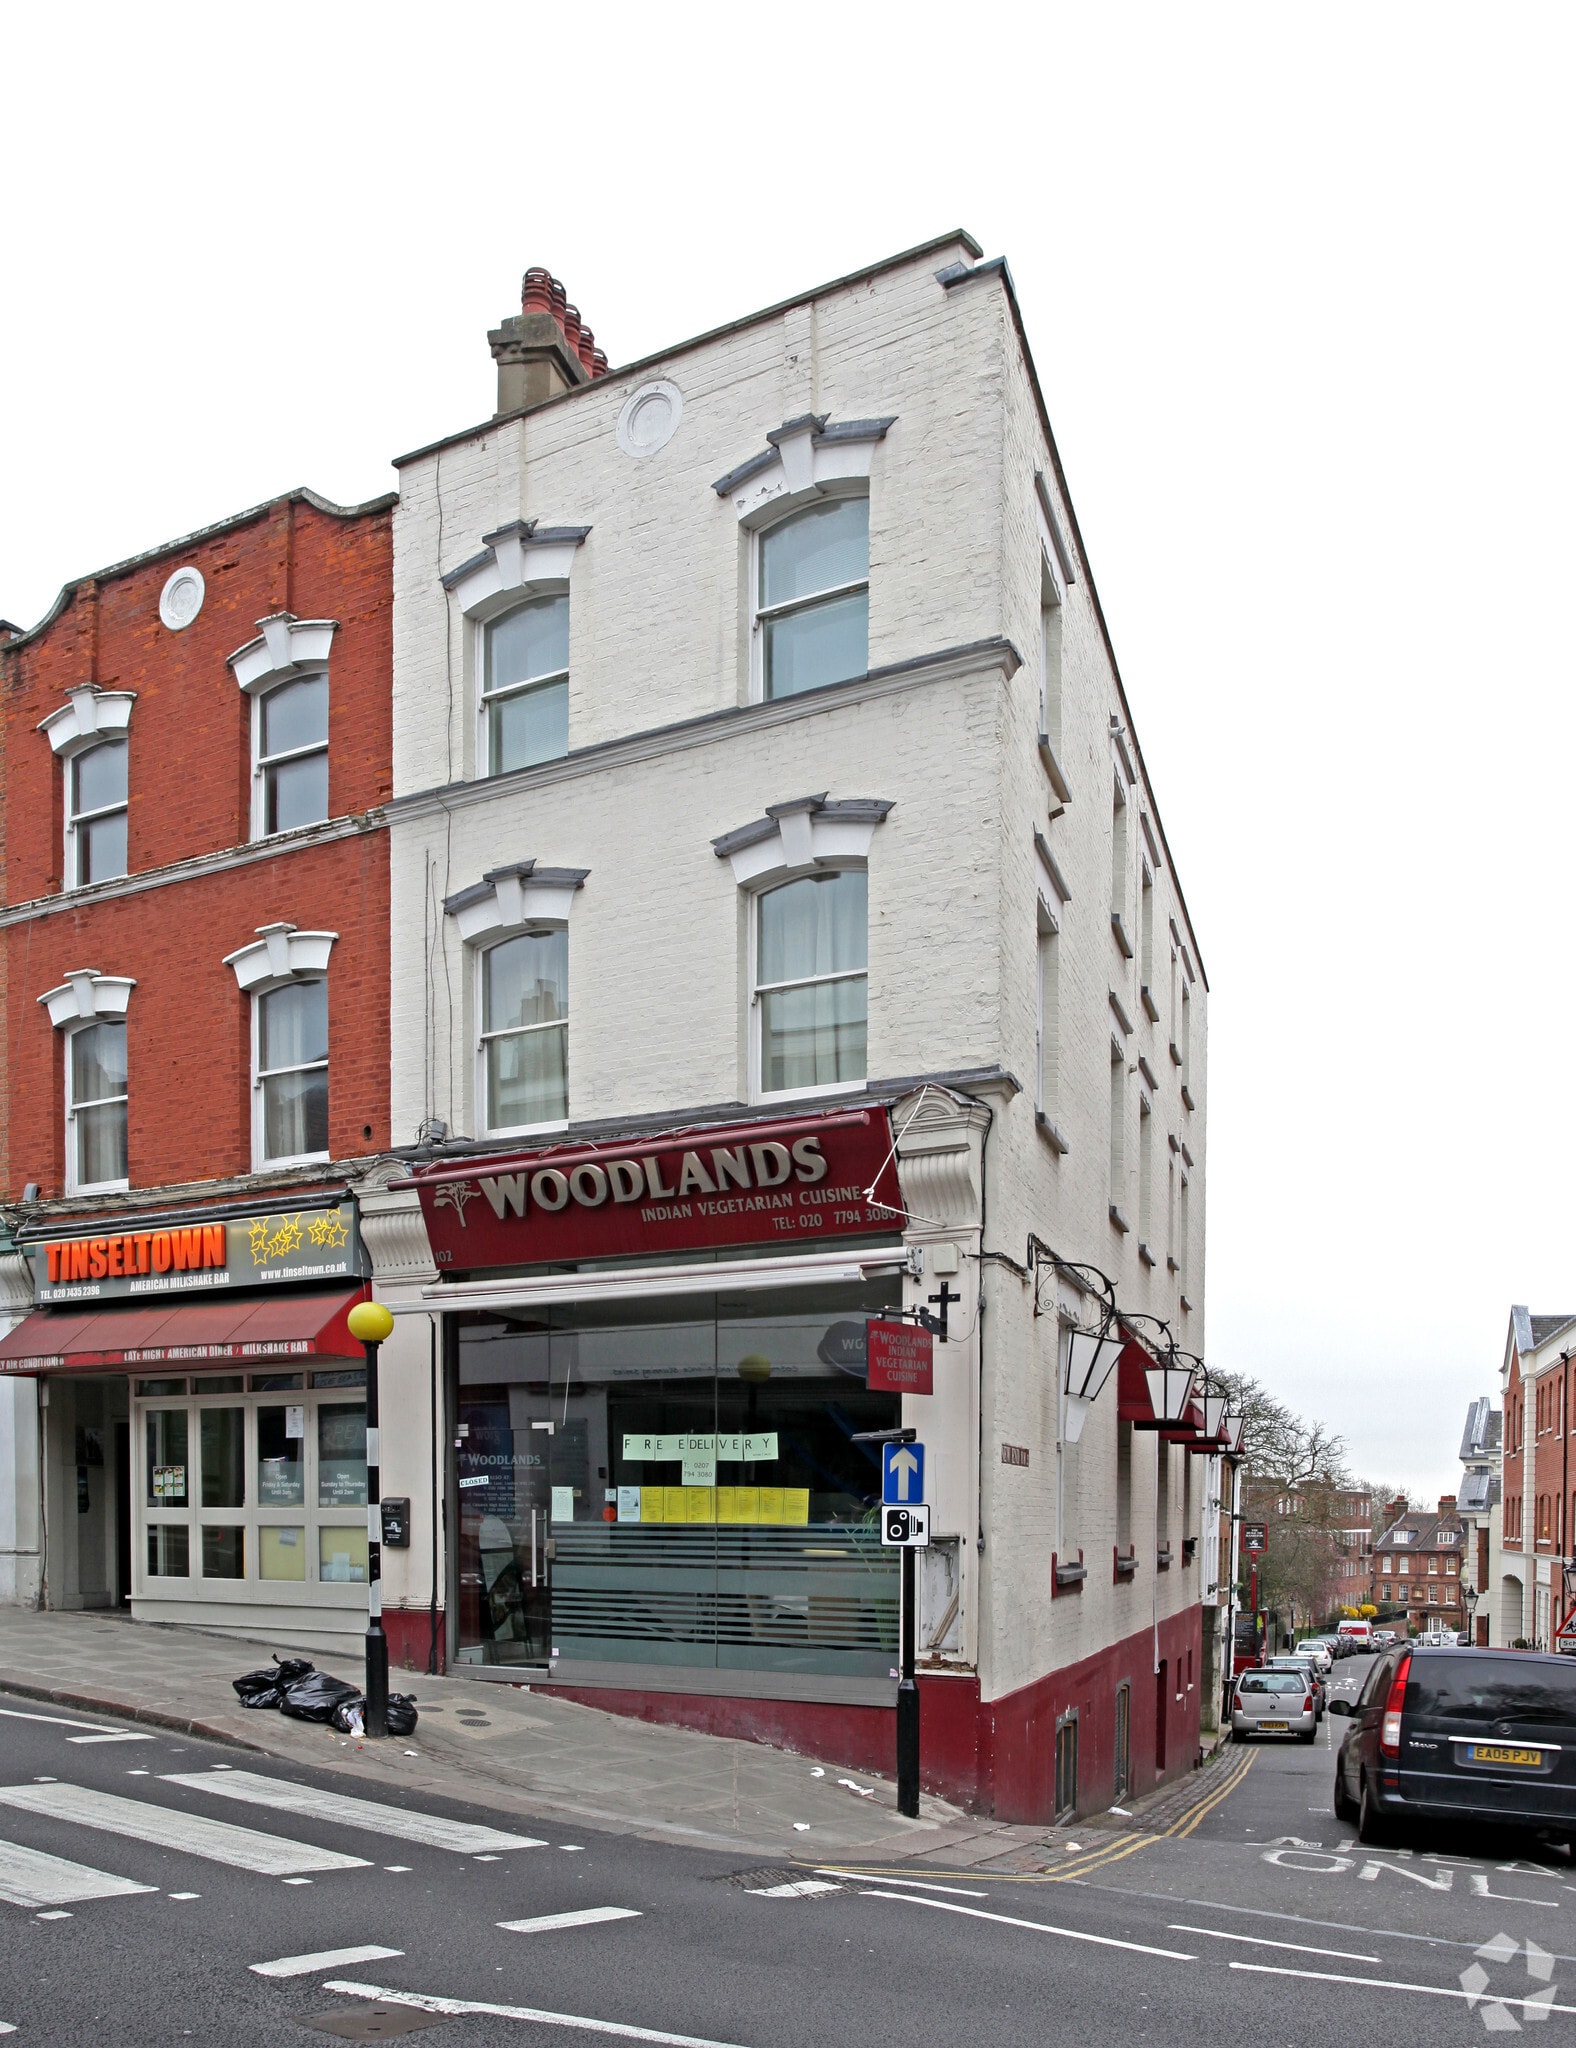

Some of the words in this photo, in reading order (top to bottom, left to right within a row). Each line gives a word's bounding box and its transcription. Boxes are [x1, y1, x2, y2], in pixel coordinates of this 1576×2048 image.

[478, 1136, 828, 1220] WOODLANDS
[641, 1204, 692, 1222] INDIAN
[697, 1193, 793, 1216] VEGETARIAN
[799, 1186, 862, 1206] CUISINE
[773, 1217, 796, 1231] TEL:
[799, 1213, 823, 1228] 020
[833, 1210, 861, 1225] 7794
[866, 1206, 897, 1222] 3080
[44, 1224, 227, 1283] TINSELTOWN
[436, 1250, 453, 1263] 102
[260, 1261, 347, 1280] www.tinseltown.co.uk
[130, 1278, 169, 1292] AMERICAN
[170, 1274, 213, 1289] MILKSHAKE
[214, 1272, 230, 1285] BAR
[40, 1290, 52, 1300] TEL.
[53, 1287, 66, 1299] 020
[66, 1286, 82, 1298] 7435
[82, 1285, 100, 1296] 2396
[880, 1331, 932, 1349] WOODLANDS
[124, 1350, 141, 1361] LATE
[142, 1348, 164, 1360] NIGHT
[167, 1346, 207, 1359] AMERICAN
[209, 1344, 232, 1357] DINER
[242, 1342, 288, 1355] MILKSHAKE
[290, 1340, 308, 1353] BAR
[888, 1346, 917, 1358] INDIAN
[6, 1360, 18, 1370] AIR
[876, 1357, 928, 1371] VEGETARIAN
[887, 1371, 918, 1382] CUISINE
[467, 1453, 541, 1467] WOODLANDS
[460, 1477, 488, 1486] CLOSED
[1476, 1747, 1510, 1760] EA05
[1513, 1750, 1538, 1762] PJV
